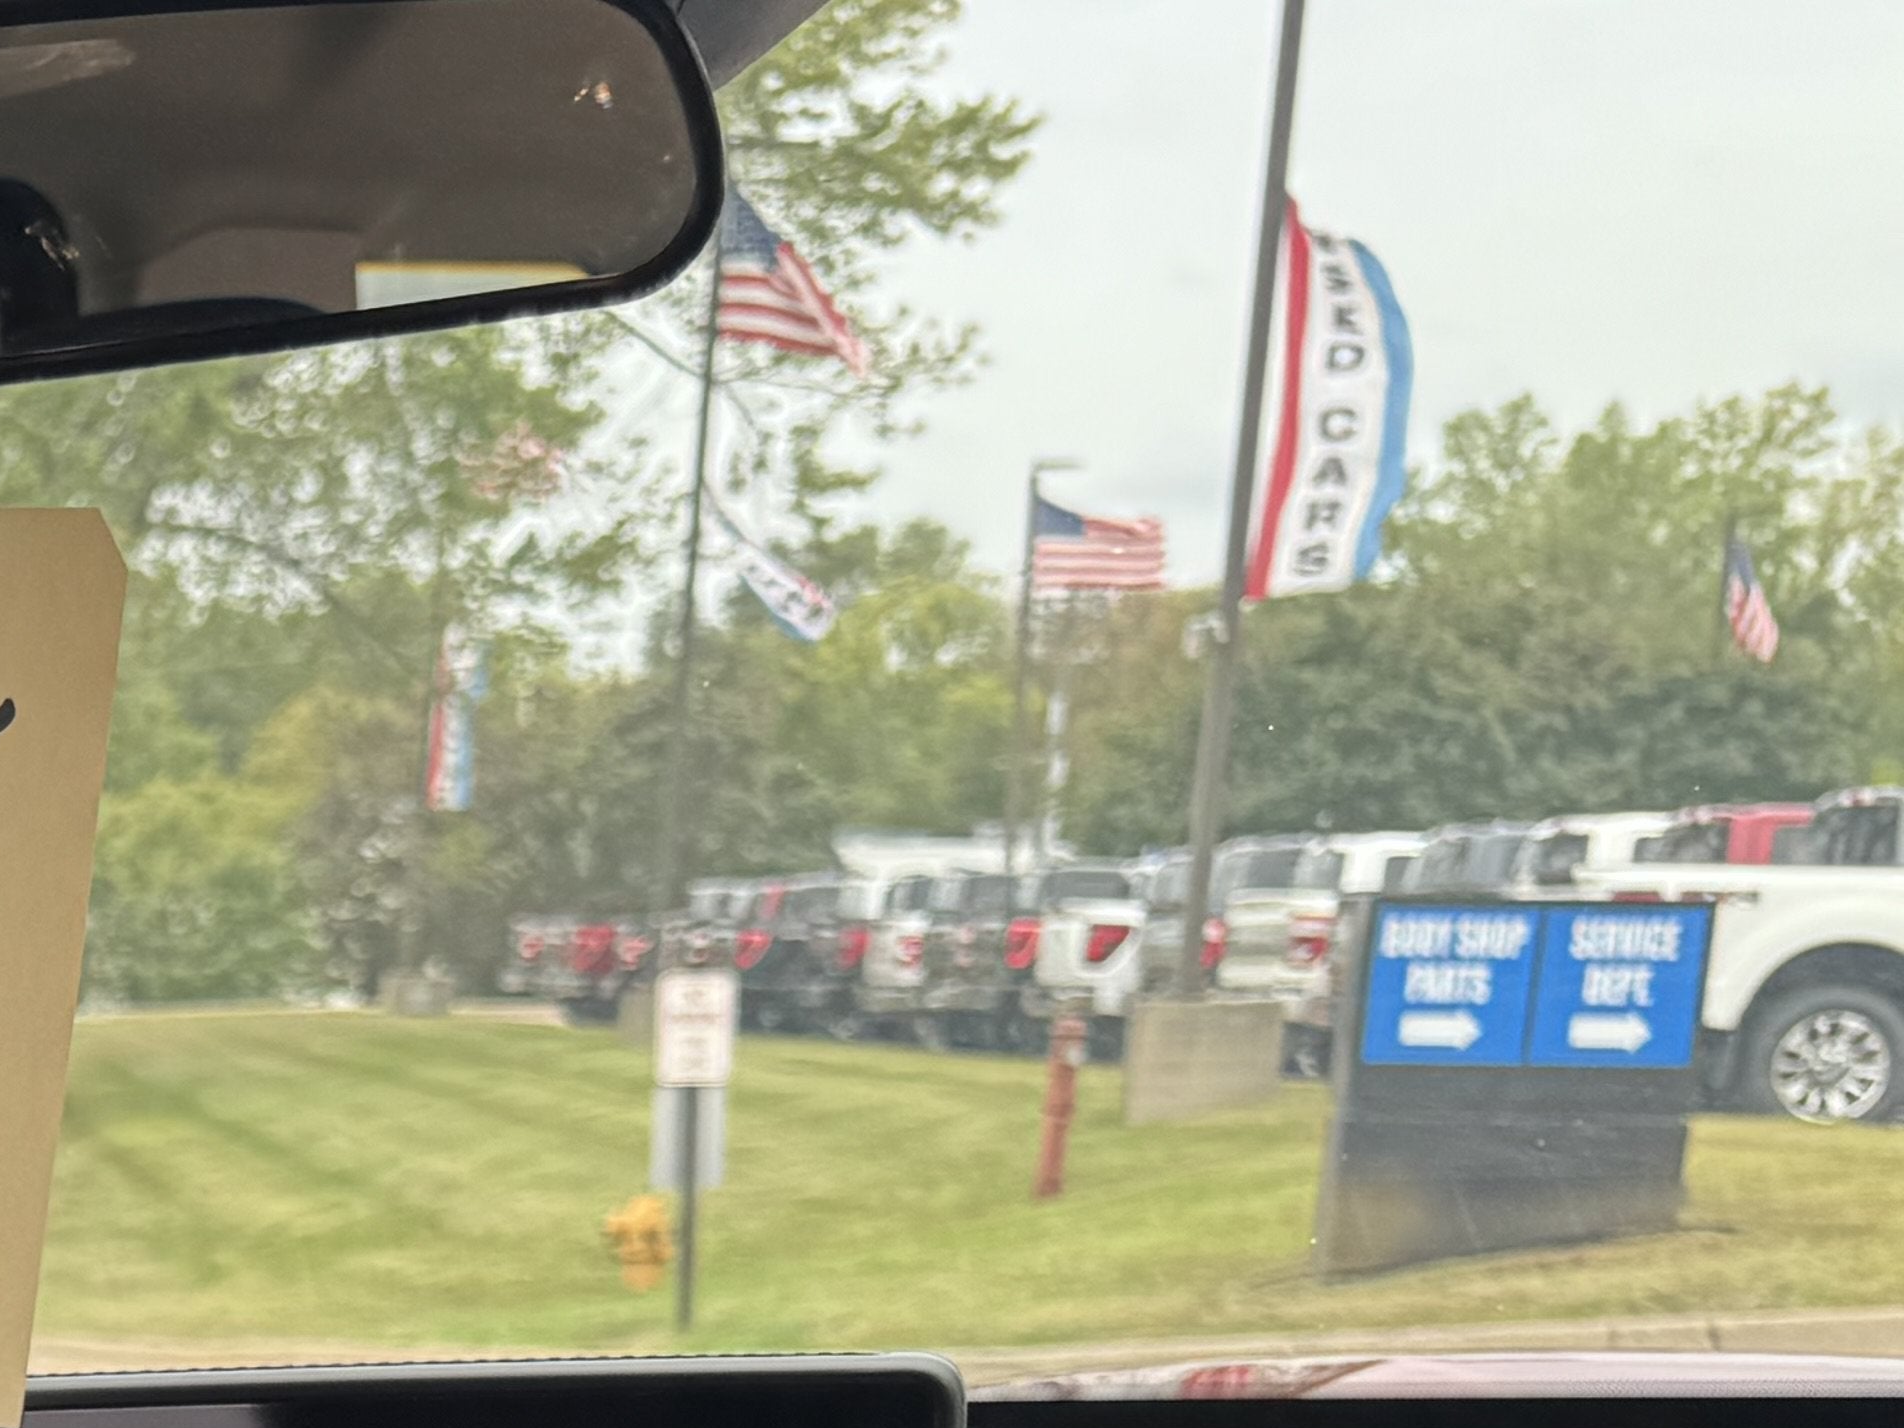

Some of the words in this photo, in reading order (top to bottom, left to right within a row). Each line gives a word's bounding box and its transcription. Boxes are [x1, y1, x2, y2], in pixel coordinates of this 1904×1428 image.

[1295, 405, 1360, 577] CARS
[1569, 915, 1683, 962] SERVICE
[1403, 961, 1492, 1006] PARTS
